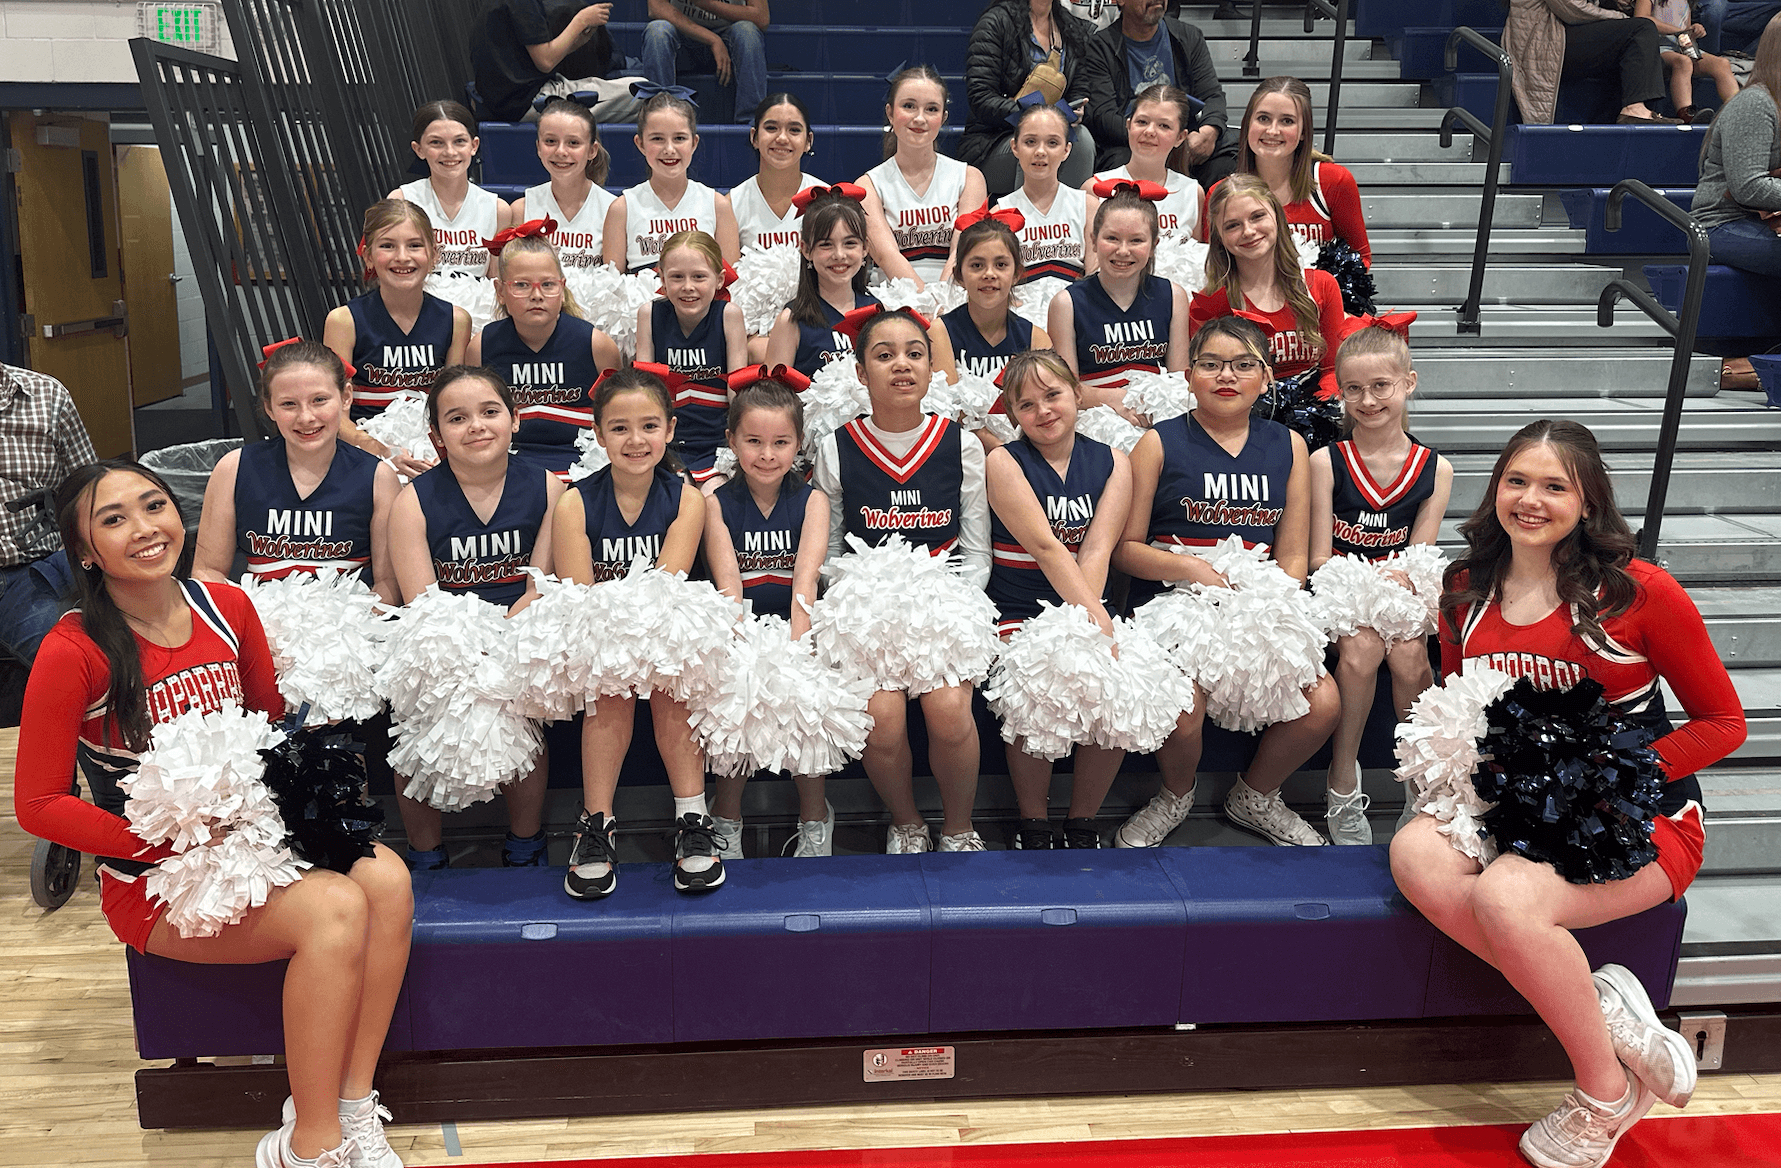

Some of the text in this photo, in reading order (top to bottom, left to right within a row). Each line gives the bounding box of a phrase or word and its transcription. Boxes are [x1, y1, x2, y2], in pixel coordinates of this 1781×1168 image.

[157, 8, 201, 43] EXIT
[648, 217, 699, 235] JUNIOR
[898, 205, 951, 228] JUNIOR
[547, 231, 594, 249] UNIOR
[1022, 223, 1071, 243] JUNIOR
[1104, 320, 1155, 343] MINI
[383, 344, 435, 367] MINI
[667, 348, 706, 366] MINI
[512, 362, 564, 385] MINI
[890, 490, 921, 506] MINI
[1204, 473, 1269, 502] MINI
[267, 508, 333, 536] MINI
[860, 506, 952, 529] Wolverines
[1357, 510, 1388, 528] MINI
[246, 531, 353, 559] Wolverines
[451, 529, 520, 561] MINI
[602, 534, 660, 562] MINI
[745, 530, 791, 551] MINI
